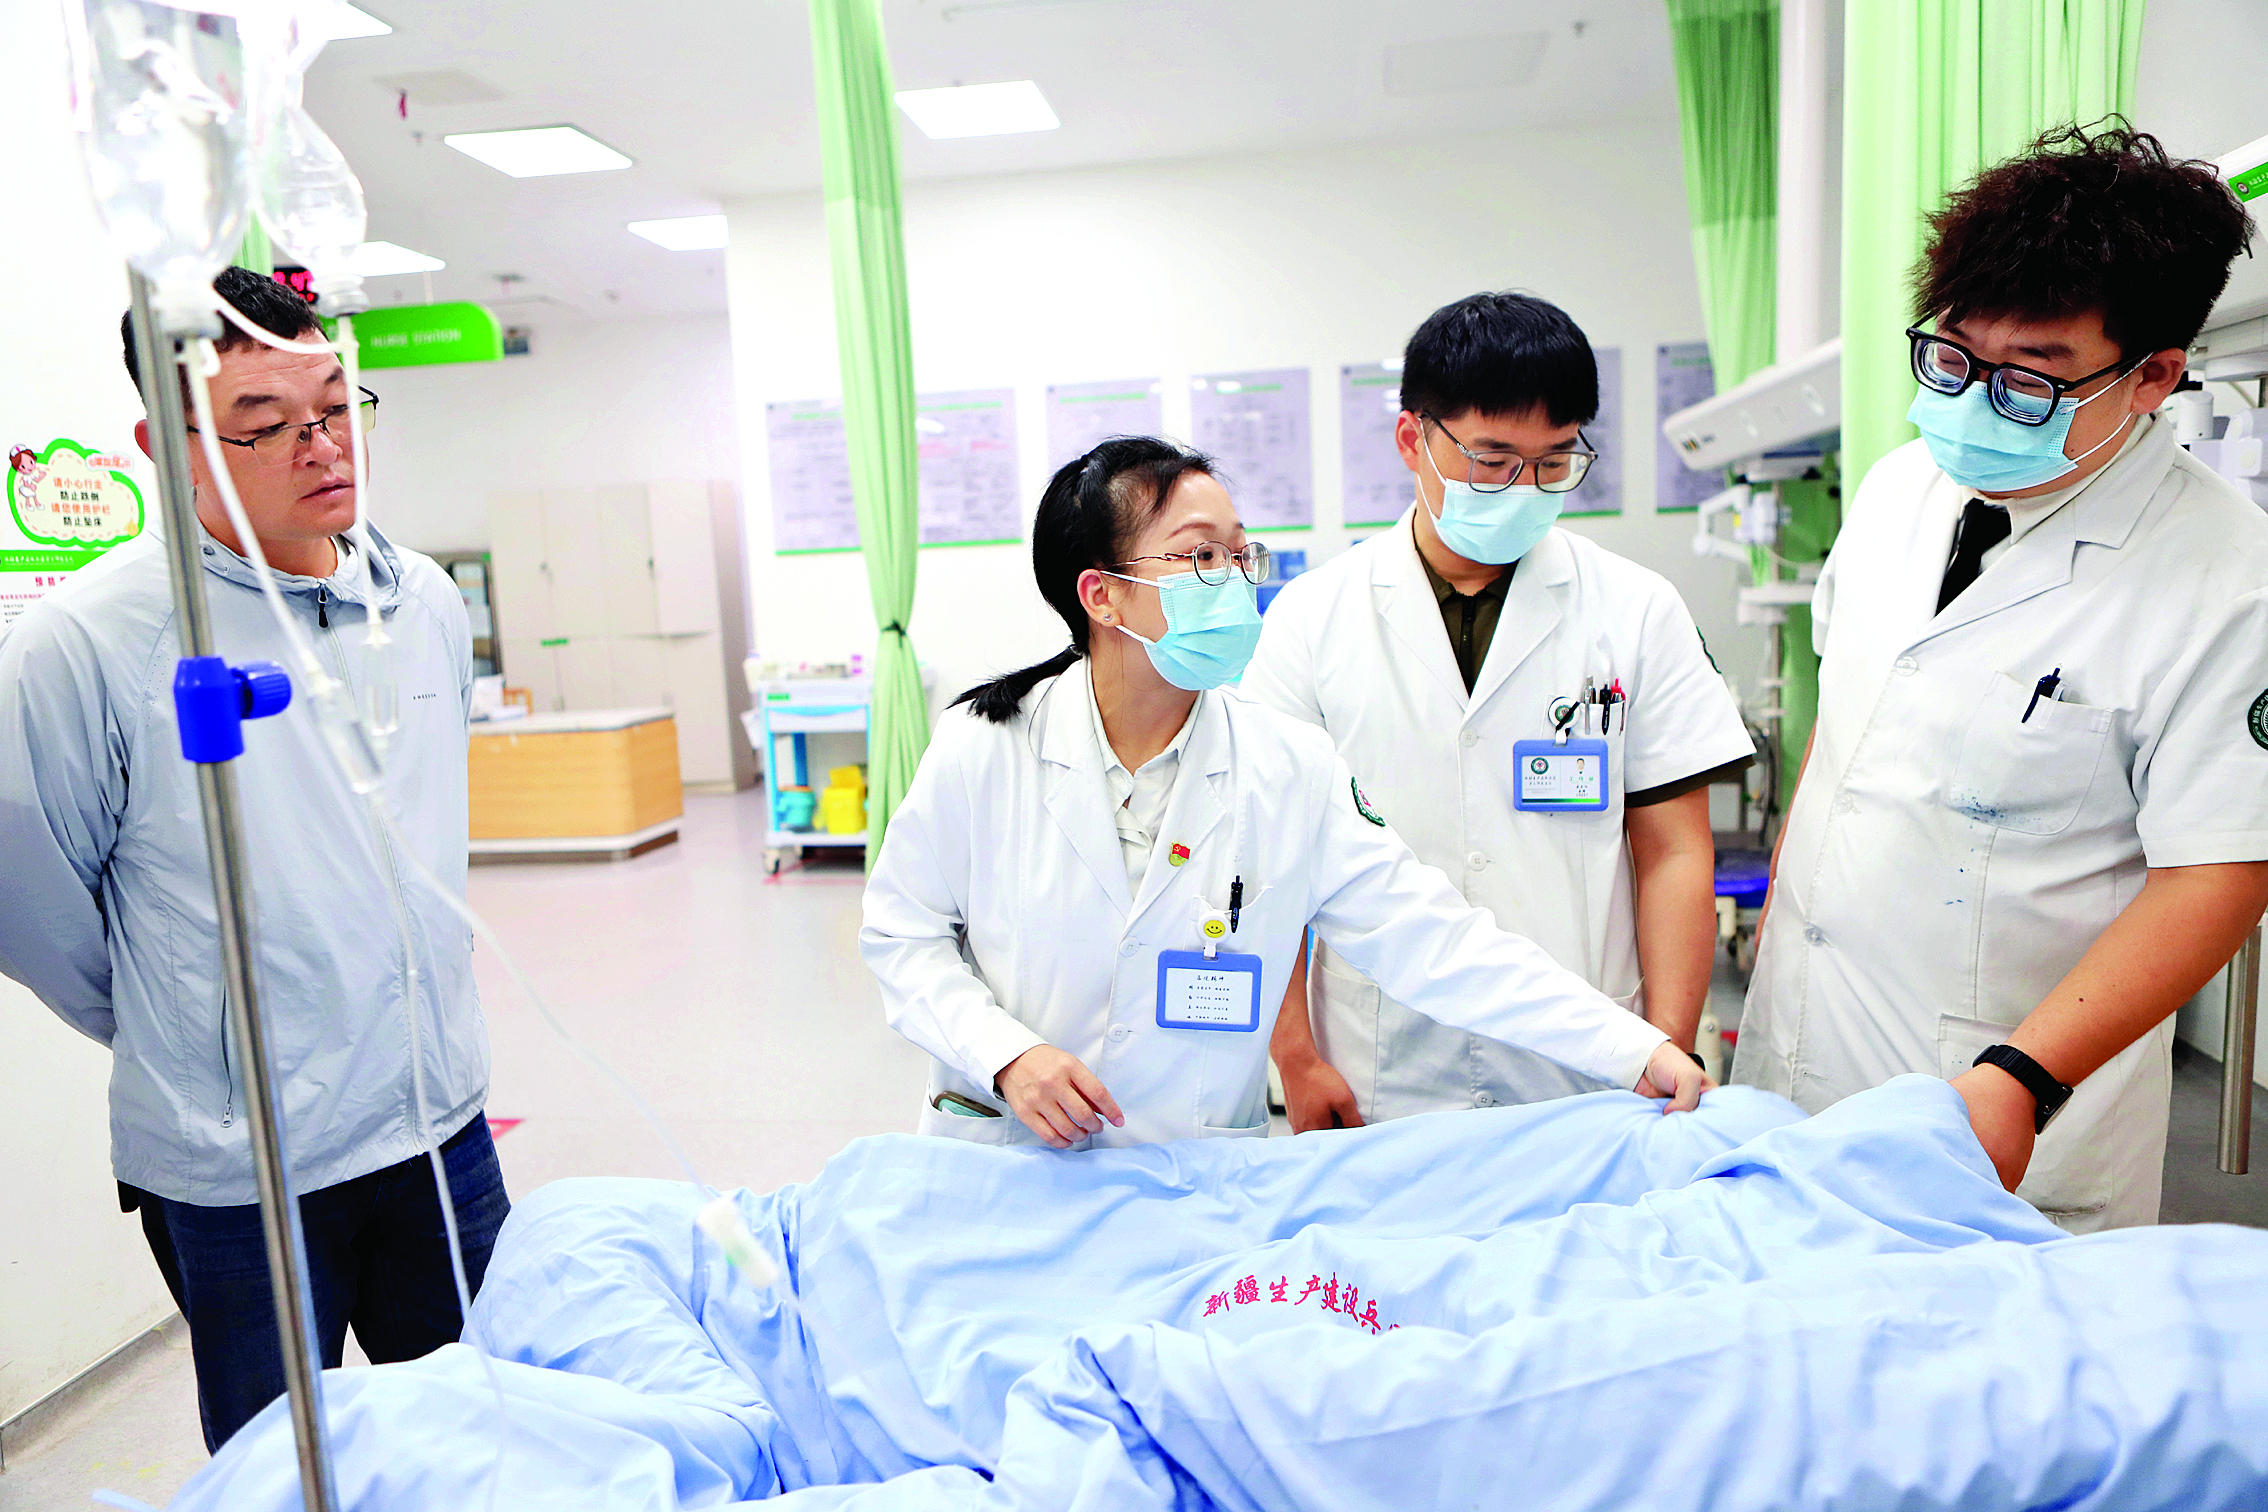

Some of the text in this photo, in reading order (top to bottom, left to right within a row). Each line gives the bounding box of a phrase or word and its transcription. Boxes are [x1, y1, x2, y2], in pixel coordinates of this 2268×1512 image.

[54, 477, 103, 491] 请小心行走
[60, 490, 99, 501] 防止跌倒
[35, 576, 66, 587] 预防
[1203, 1272, 1400, 1335] 新疆生产建设兵
